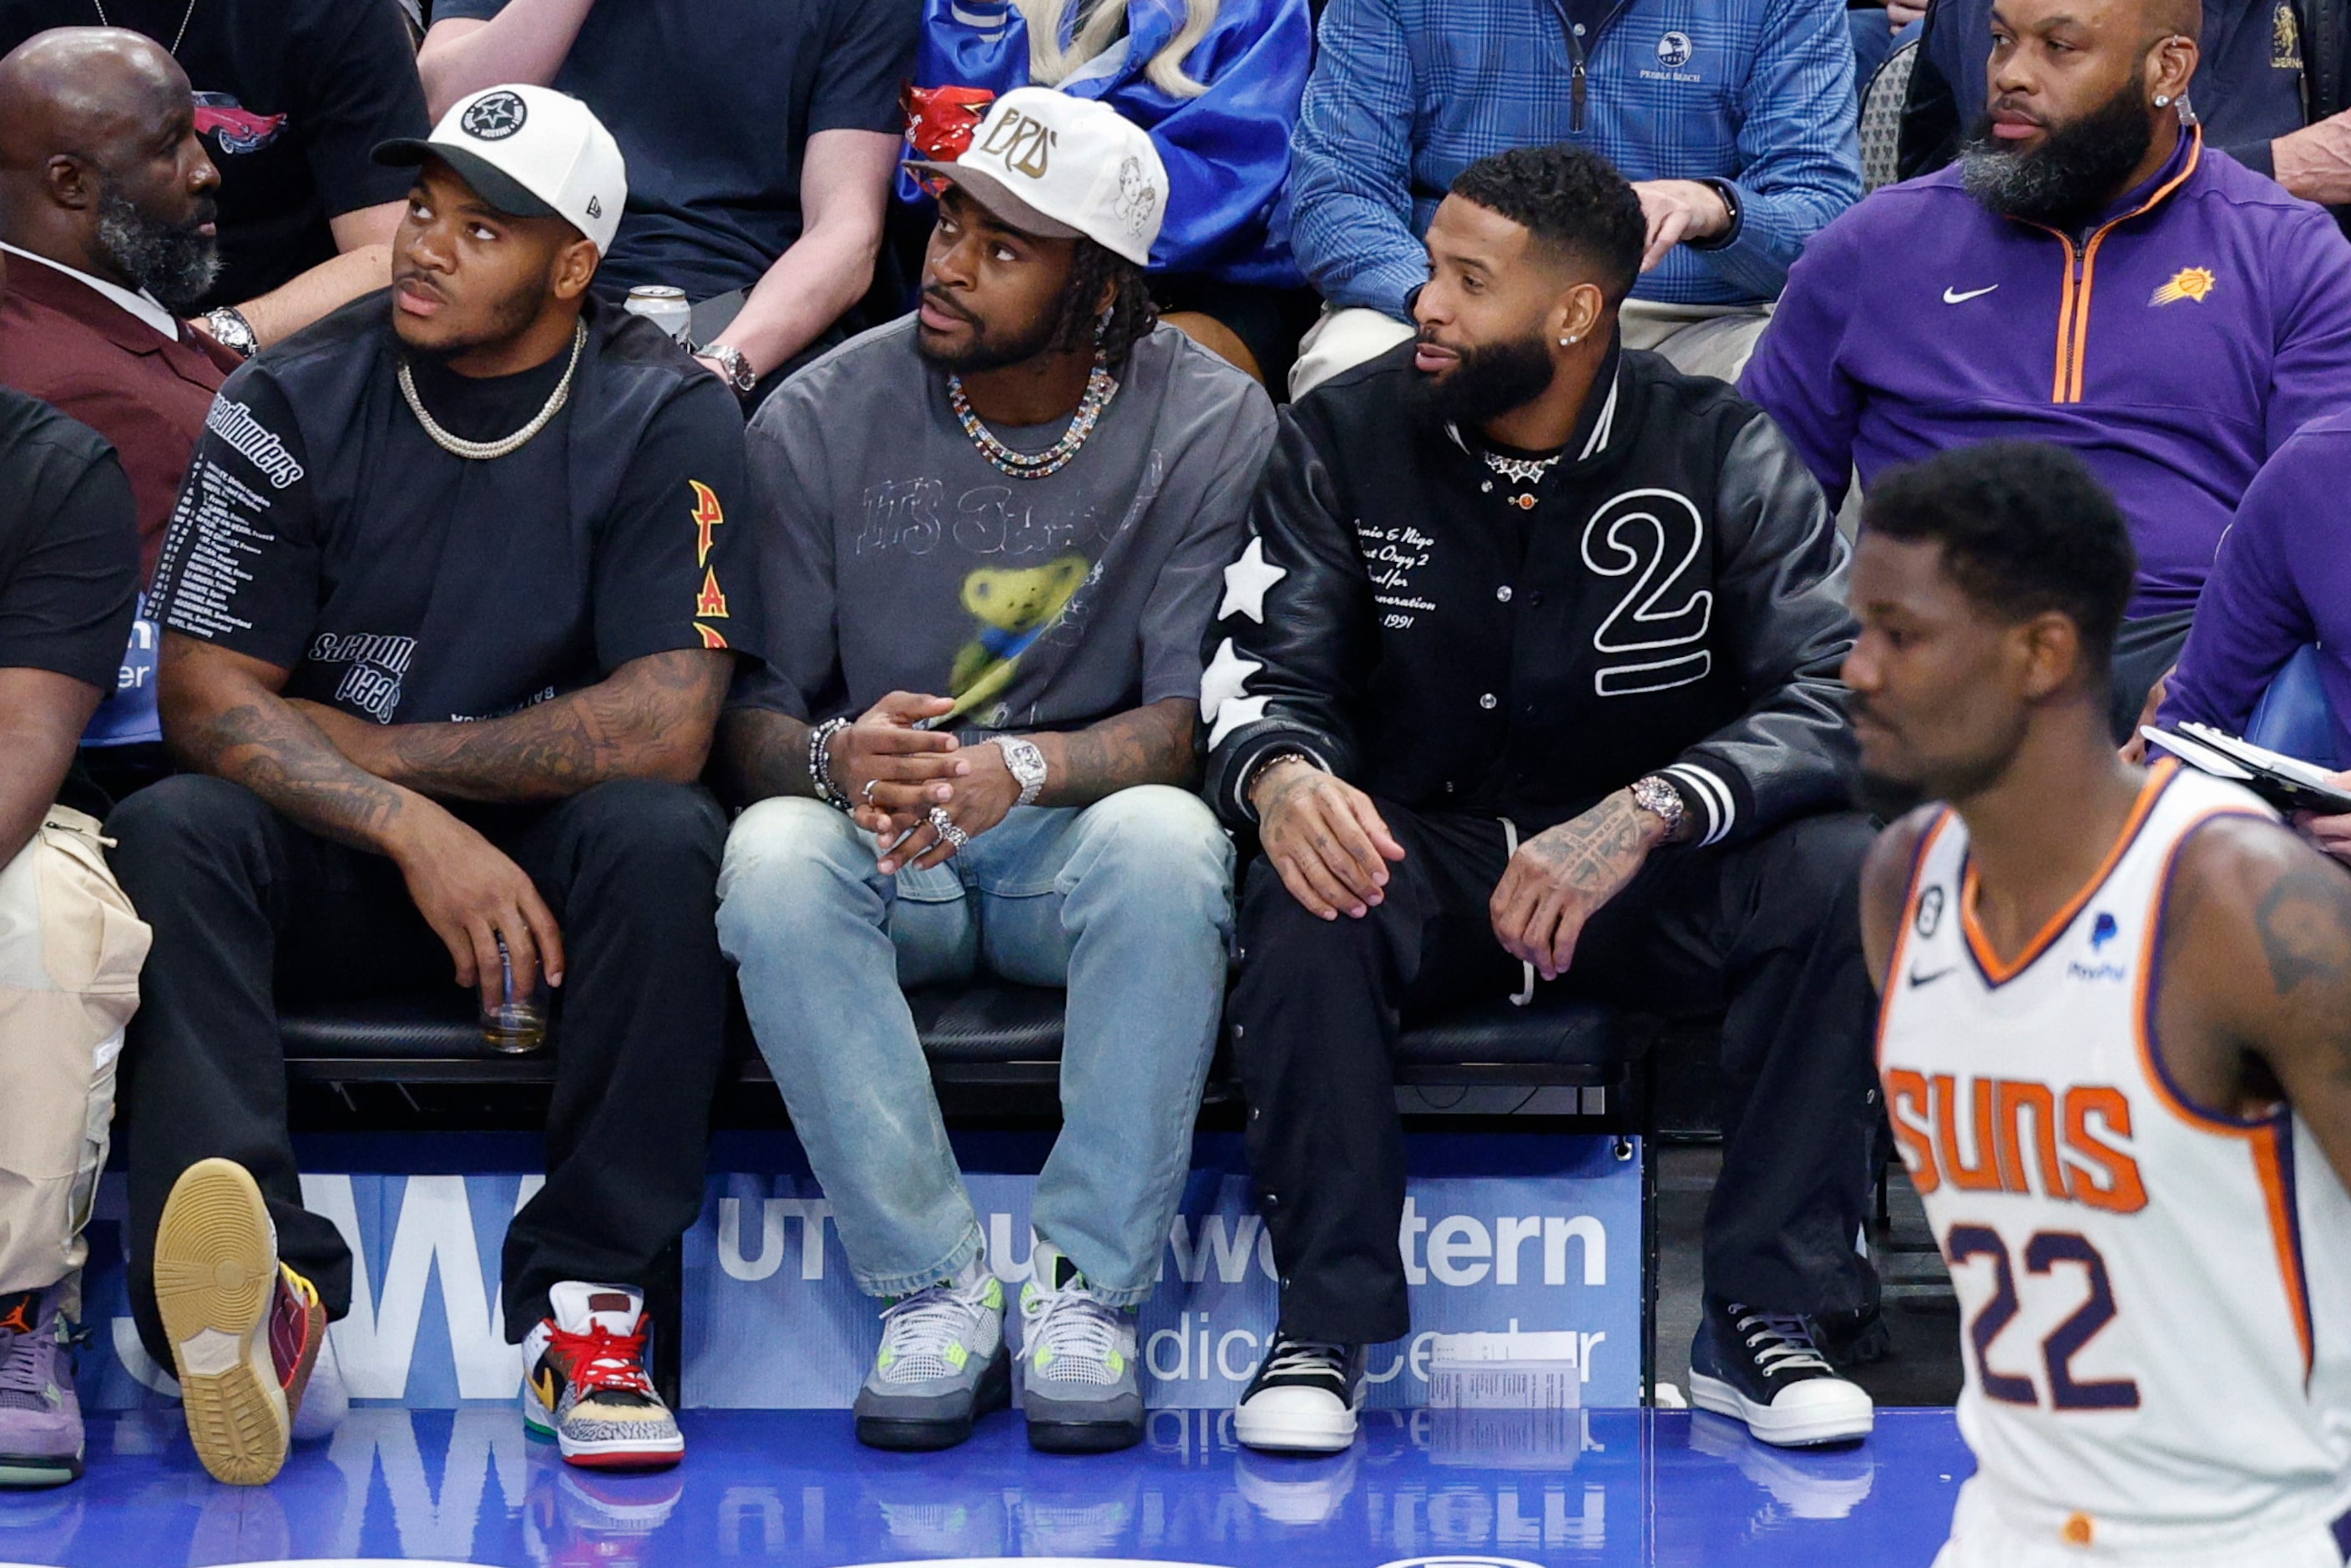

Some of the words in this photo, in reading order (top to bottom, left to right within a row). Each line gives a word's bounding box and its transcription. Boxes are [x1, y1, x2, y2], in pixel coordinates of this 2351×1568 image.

[1640, 70, 1671, 80] PEBBLE
[1672, 72, 1701, 82] BEACH
[1386, 528, 1399, 541] &
[1400, 527, 1435, 551] Nigo
[1378, 544, 1416, 570] Orgy
[1416, 554, 1429, 566] 2
[1385, 569, 1408, 590] for
[1581, 488, 1713, 653] 2
[1383, 614, 1414, 630] 1991
[127, 620, 151, 650] n
[118, 665, 150, 688] er
[1885, 1068, 2149, 1214] SUNS
[1947, 1222, 2141, 1411] 22
